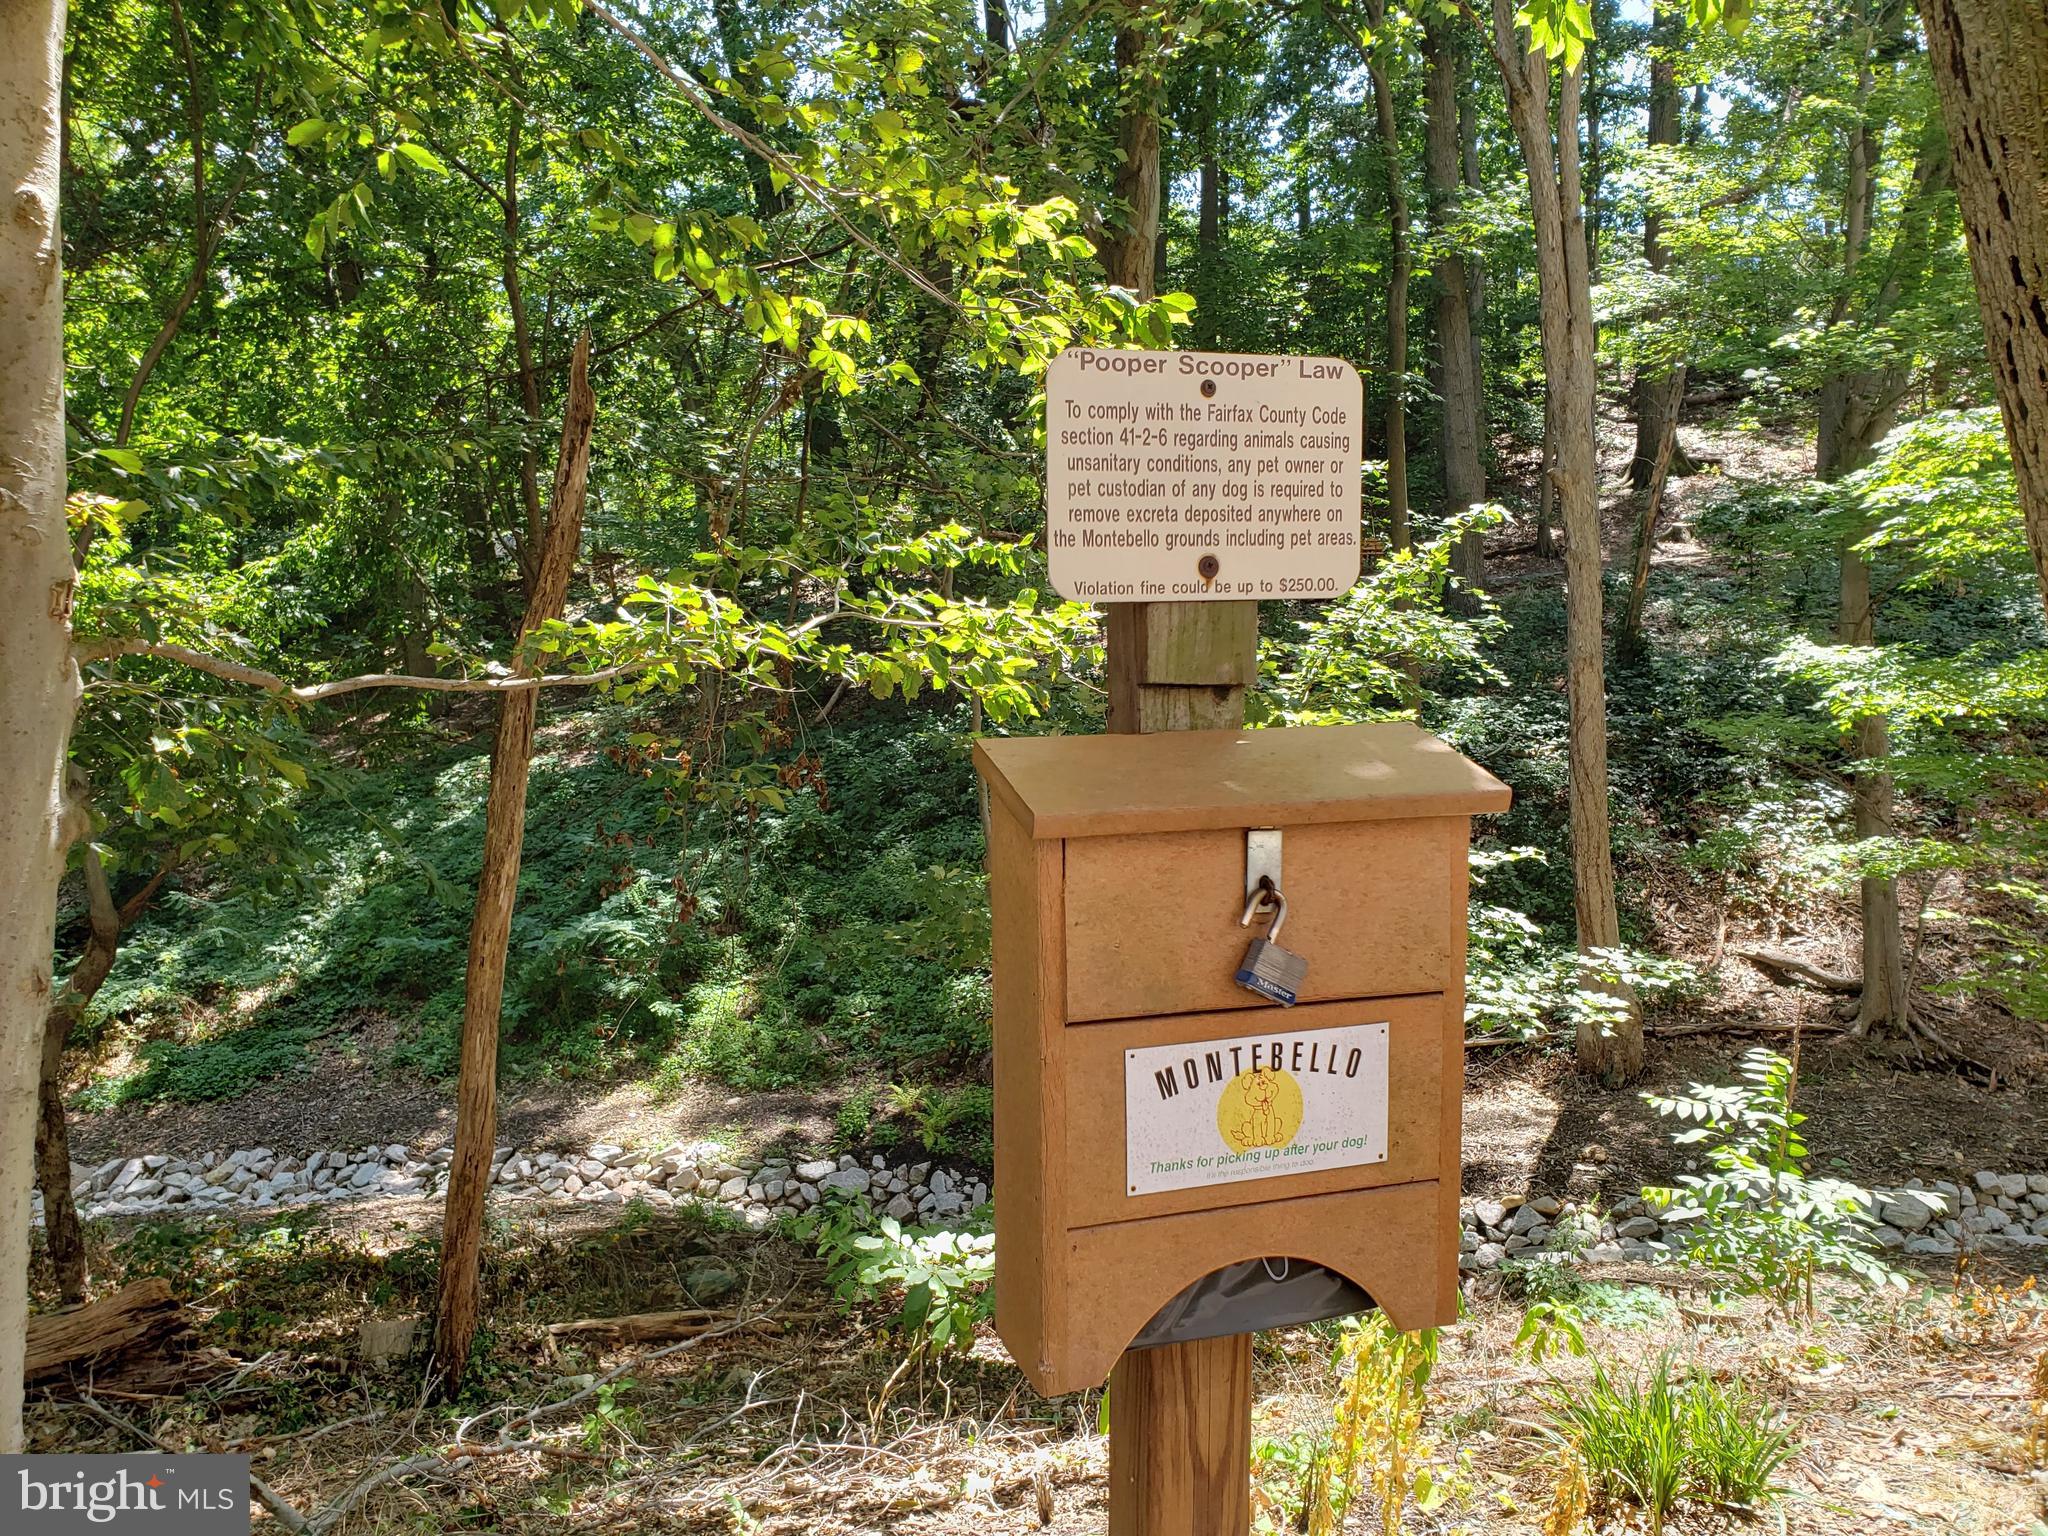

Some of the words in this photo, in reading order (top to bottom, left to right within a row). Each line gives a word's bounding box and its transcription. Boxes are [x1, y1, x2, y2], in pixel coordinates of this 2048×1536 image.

[1067, 351, 1167, 376] “Pooper
[1178, 355, 1291, 380] Scooper”
[1299, 360, 1343, 379] Law
[1065, 400, 1081, 419] To
[1088, 401, 1138, 423] comply
[1145, 403, 1173, 421] with
[1180, 403, 1201, 421] the
[1208, 404, 1253, 422] Fairfax
[1259, 405, 1306, 426] County
[1312, 406, 1346, 424] Code
[1061, 427, 1113, 445] section
[1119, 428, 1167, 446] 41-2-6
[1174, 429, 1238, 450] regarding
[1244, 430, 1294, 448] animals
[1300, 431, 1350, 452] causing
[1067, 453, 1140, 474] unsanitary
[1147, 454, 1222, 475] conditions,
[1228, 459, 1251, 477] any
[1257, 457, 1279, 476] pet
[1285, 459, 1325, 474] owner
[1330, 459, 1343, 474] or
[1068, 479, 1091, 500] pet
[1098, 479, 1166, 497] custodian
[1172, 480, 1185, 497] of
[1192, 483, 1215, 501] any
[1222, 480, 1248, 501] dog
[1253, 480, 1264, 497] is
[1270, 480, 1324, 501] required
[1330, 481, 1343, 497] to
[1068, 507, 1120, 523] remove
[1127, 506, 1178, 522] excreta
[1184, 505, 1251, 526] deposited
[1258, 504, 1321, 525] anywhere
[1327, 507, 1343, 522] on
[1054, 530, 1076, 547] the
[1082, 530, 1159, 548] Montebello
[1165, 529, 1220, 550] grounds
[1226, 529, 1285, 550] including
[1290, 529, 1312, 549] pet
[1318, 530, 1356, 546] areas.
[1074, 580, 1134, 596] Violation
[1140, 580, 1165, 595] fine
[1172, 579, 1209, 594] could
[1215, 579, 1232, 594] be
[1238, 582, 1253, 598] up
[1260, 579, 1273, 593] to
[1279, 577, 1338, 593] $250.00.
[1257, 977, 1292, 998] Master
[1155, 1042, 1362, 1100] MONTEBELLO
[1150, 1156, 1193, 1174] Thanks
[1197, 1152, 1215, 1168] for
[1217, 1147, 1260, 1167] picking
[1265, 1148, 1279, 1160] up
[1283, 1143, 1308, 1156] after
[1312, 1141, 1339, 1155] your
[1342, 1135, 1368, 1149] dog!
